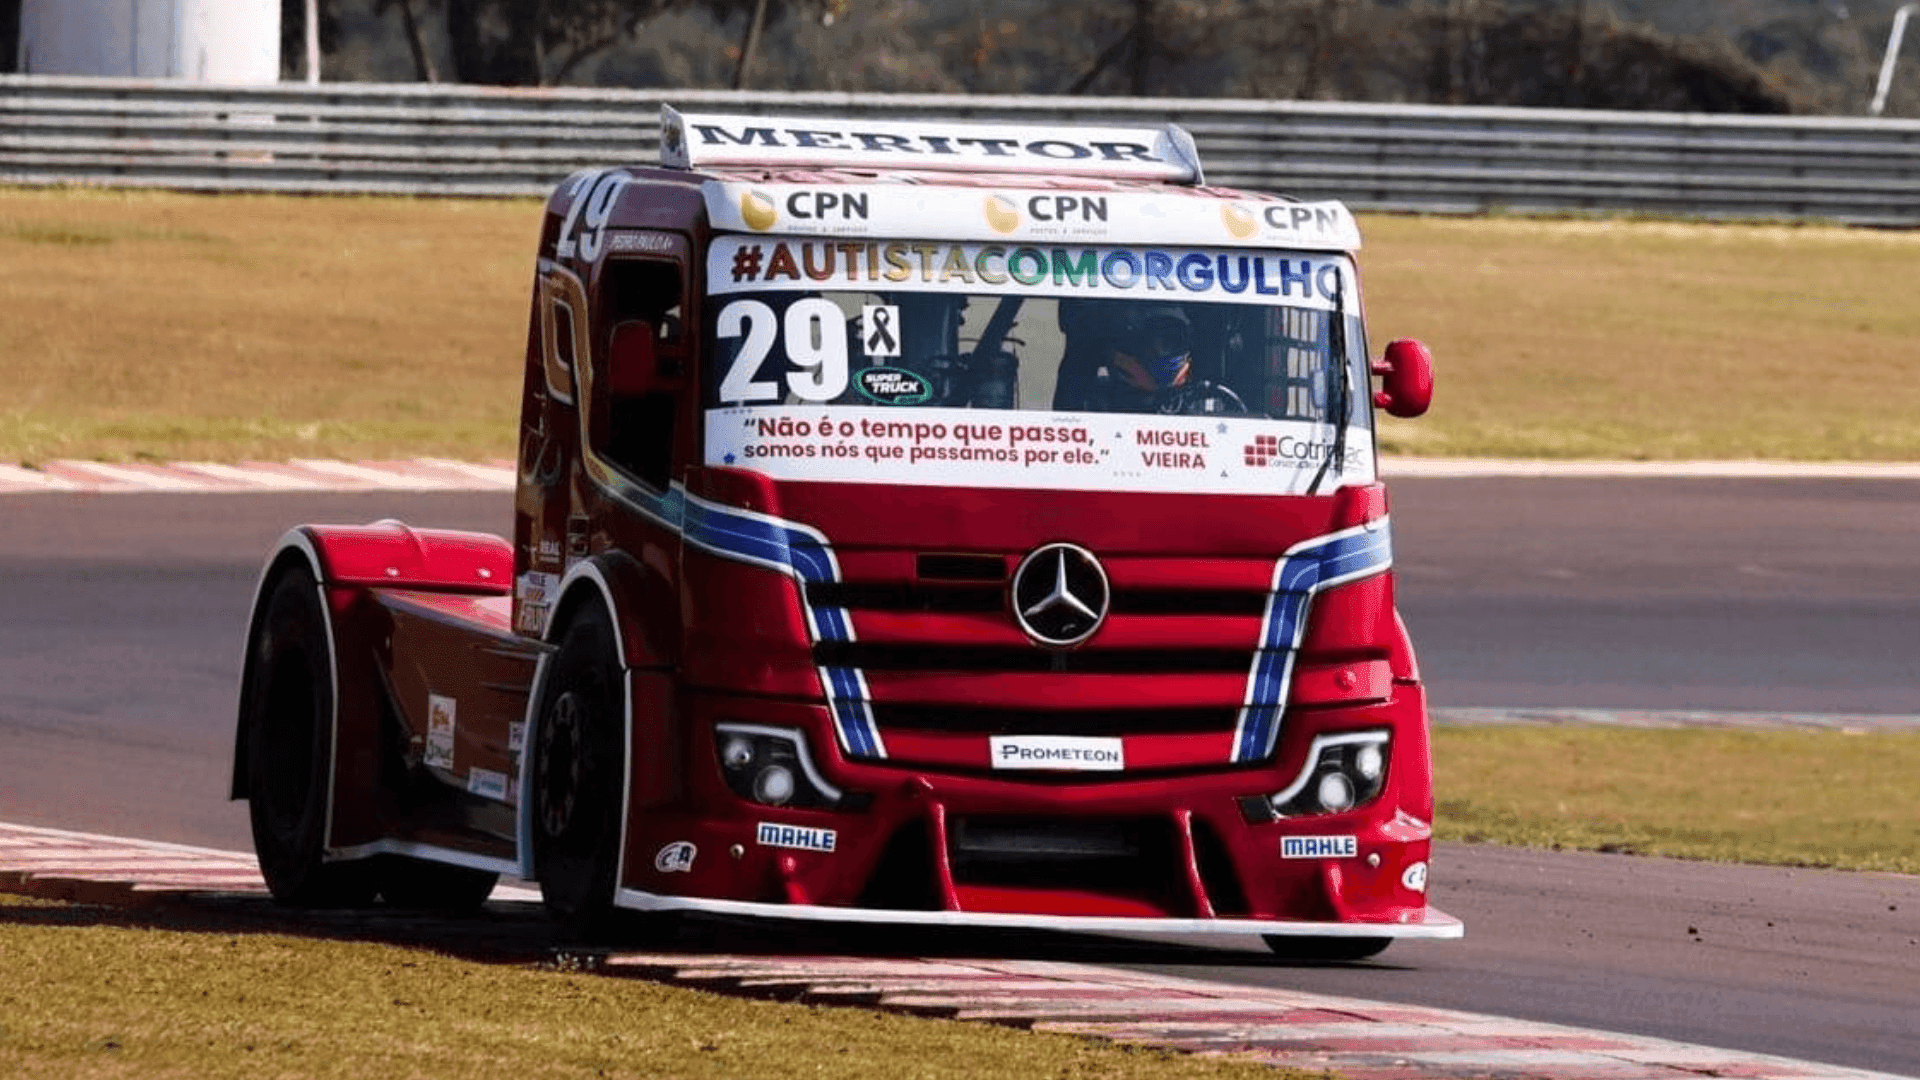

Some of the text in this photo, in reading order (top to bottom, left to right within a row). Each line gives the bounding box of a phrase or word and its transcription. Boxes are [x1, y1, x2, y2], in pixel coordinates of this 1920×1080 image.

[691, 124, 1163, 163] MERITOR
[557, 169, 632, 262] 29
[786, 192, 868, 220] CPN
[1028, 196, 1107, 222] CPN
[1264, 206, 1338, 234] CPN
[731, 241, 1347, 303] #AUTISTACOMORGULHO
[717, 298, 848, 402] 29
[866, 374, 902, 383] SUPER
[872, 381, 918, 393] TRUCK
[818, 415, 833, 437] é
[839, 422, 854, 437] o
[861, 418, 947, 444] tempo
[953, 425, 1002, 446] que
[1009, 426, 1094, 447] passa,
[1136, 430, 1209, 448] MIGUEL
[744, 444, 815, 457] somos
[821, 440, 859, 458] nós
[865, 445, 904, 463] que
[910, 447, 1018, 464] passamos
[1025, 449, 1058, 467] por
[1141, 452, 1206, 469] VIEIRA
[1001, 744, 1119, 762] PROMETEON
[760, 826, 834, 849] MAHLE
[1284, 838, 1355, 856] MAHLE
